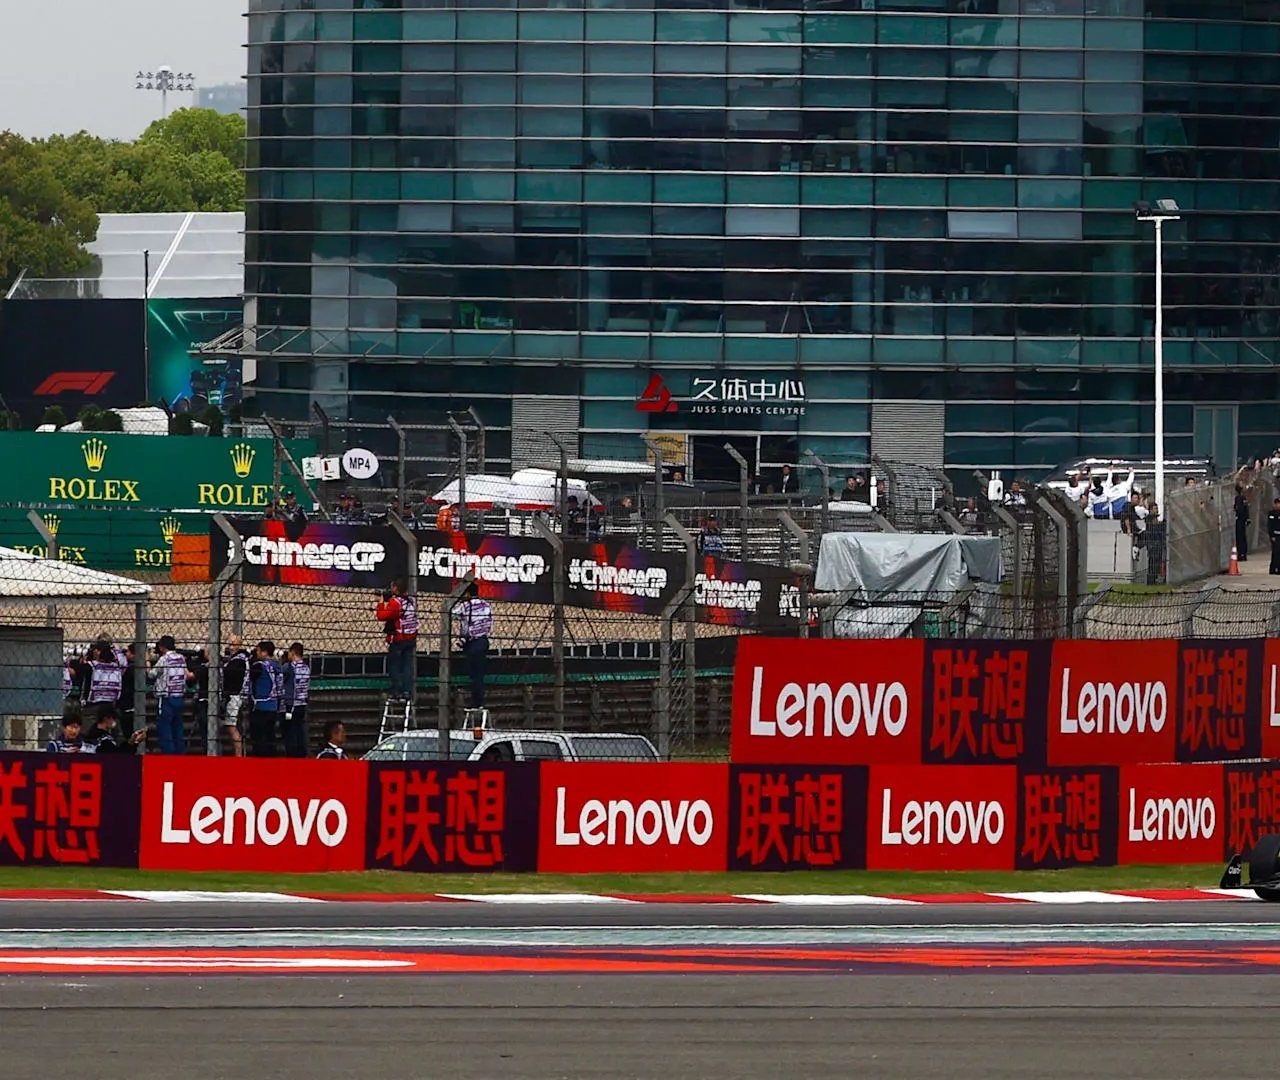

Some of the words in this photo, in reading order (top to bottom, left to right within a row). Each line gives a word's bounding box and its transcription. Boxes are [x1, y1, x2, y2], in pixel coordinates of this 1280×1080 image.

[691, 377, 806, 401] 久体中心
[721, 406, 761, 414] SPORTS
[765, 407, 806, 415] CENTRE
[49, 477, 141, 502] ROLEX
[349, 456, 371, 471] MP4
[418, 546, 546, 584] #ChineseGP
[750, 666, 908, 738] Lenovo
[930, 648, 1029, 759] 联想
[1060, 667, 1168, 735] Lenovo
[1180, 648, 1249, 754] 联想
[160, 781, 348, 847] Lenovo
[378, 769, 505, 867] 联想
[555, 786, 714, 847] Lenovo
[736, 772, 843, 866] 联想
[881, 788, 1005, 845] Lenovo
[1021, 773, 1101, 862] 联想
[1128, 787, 1216, 842] Lenovo
